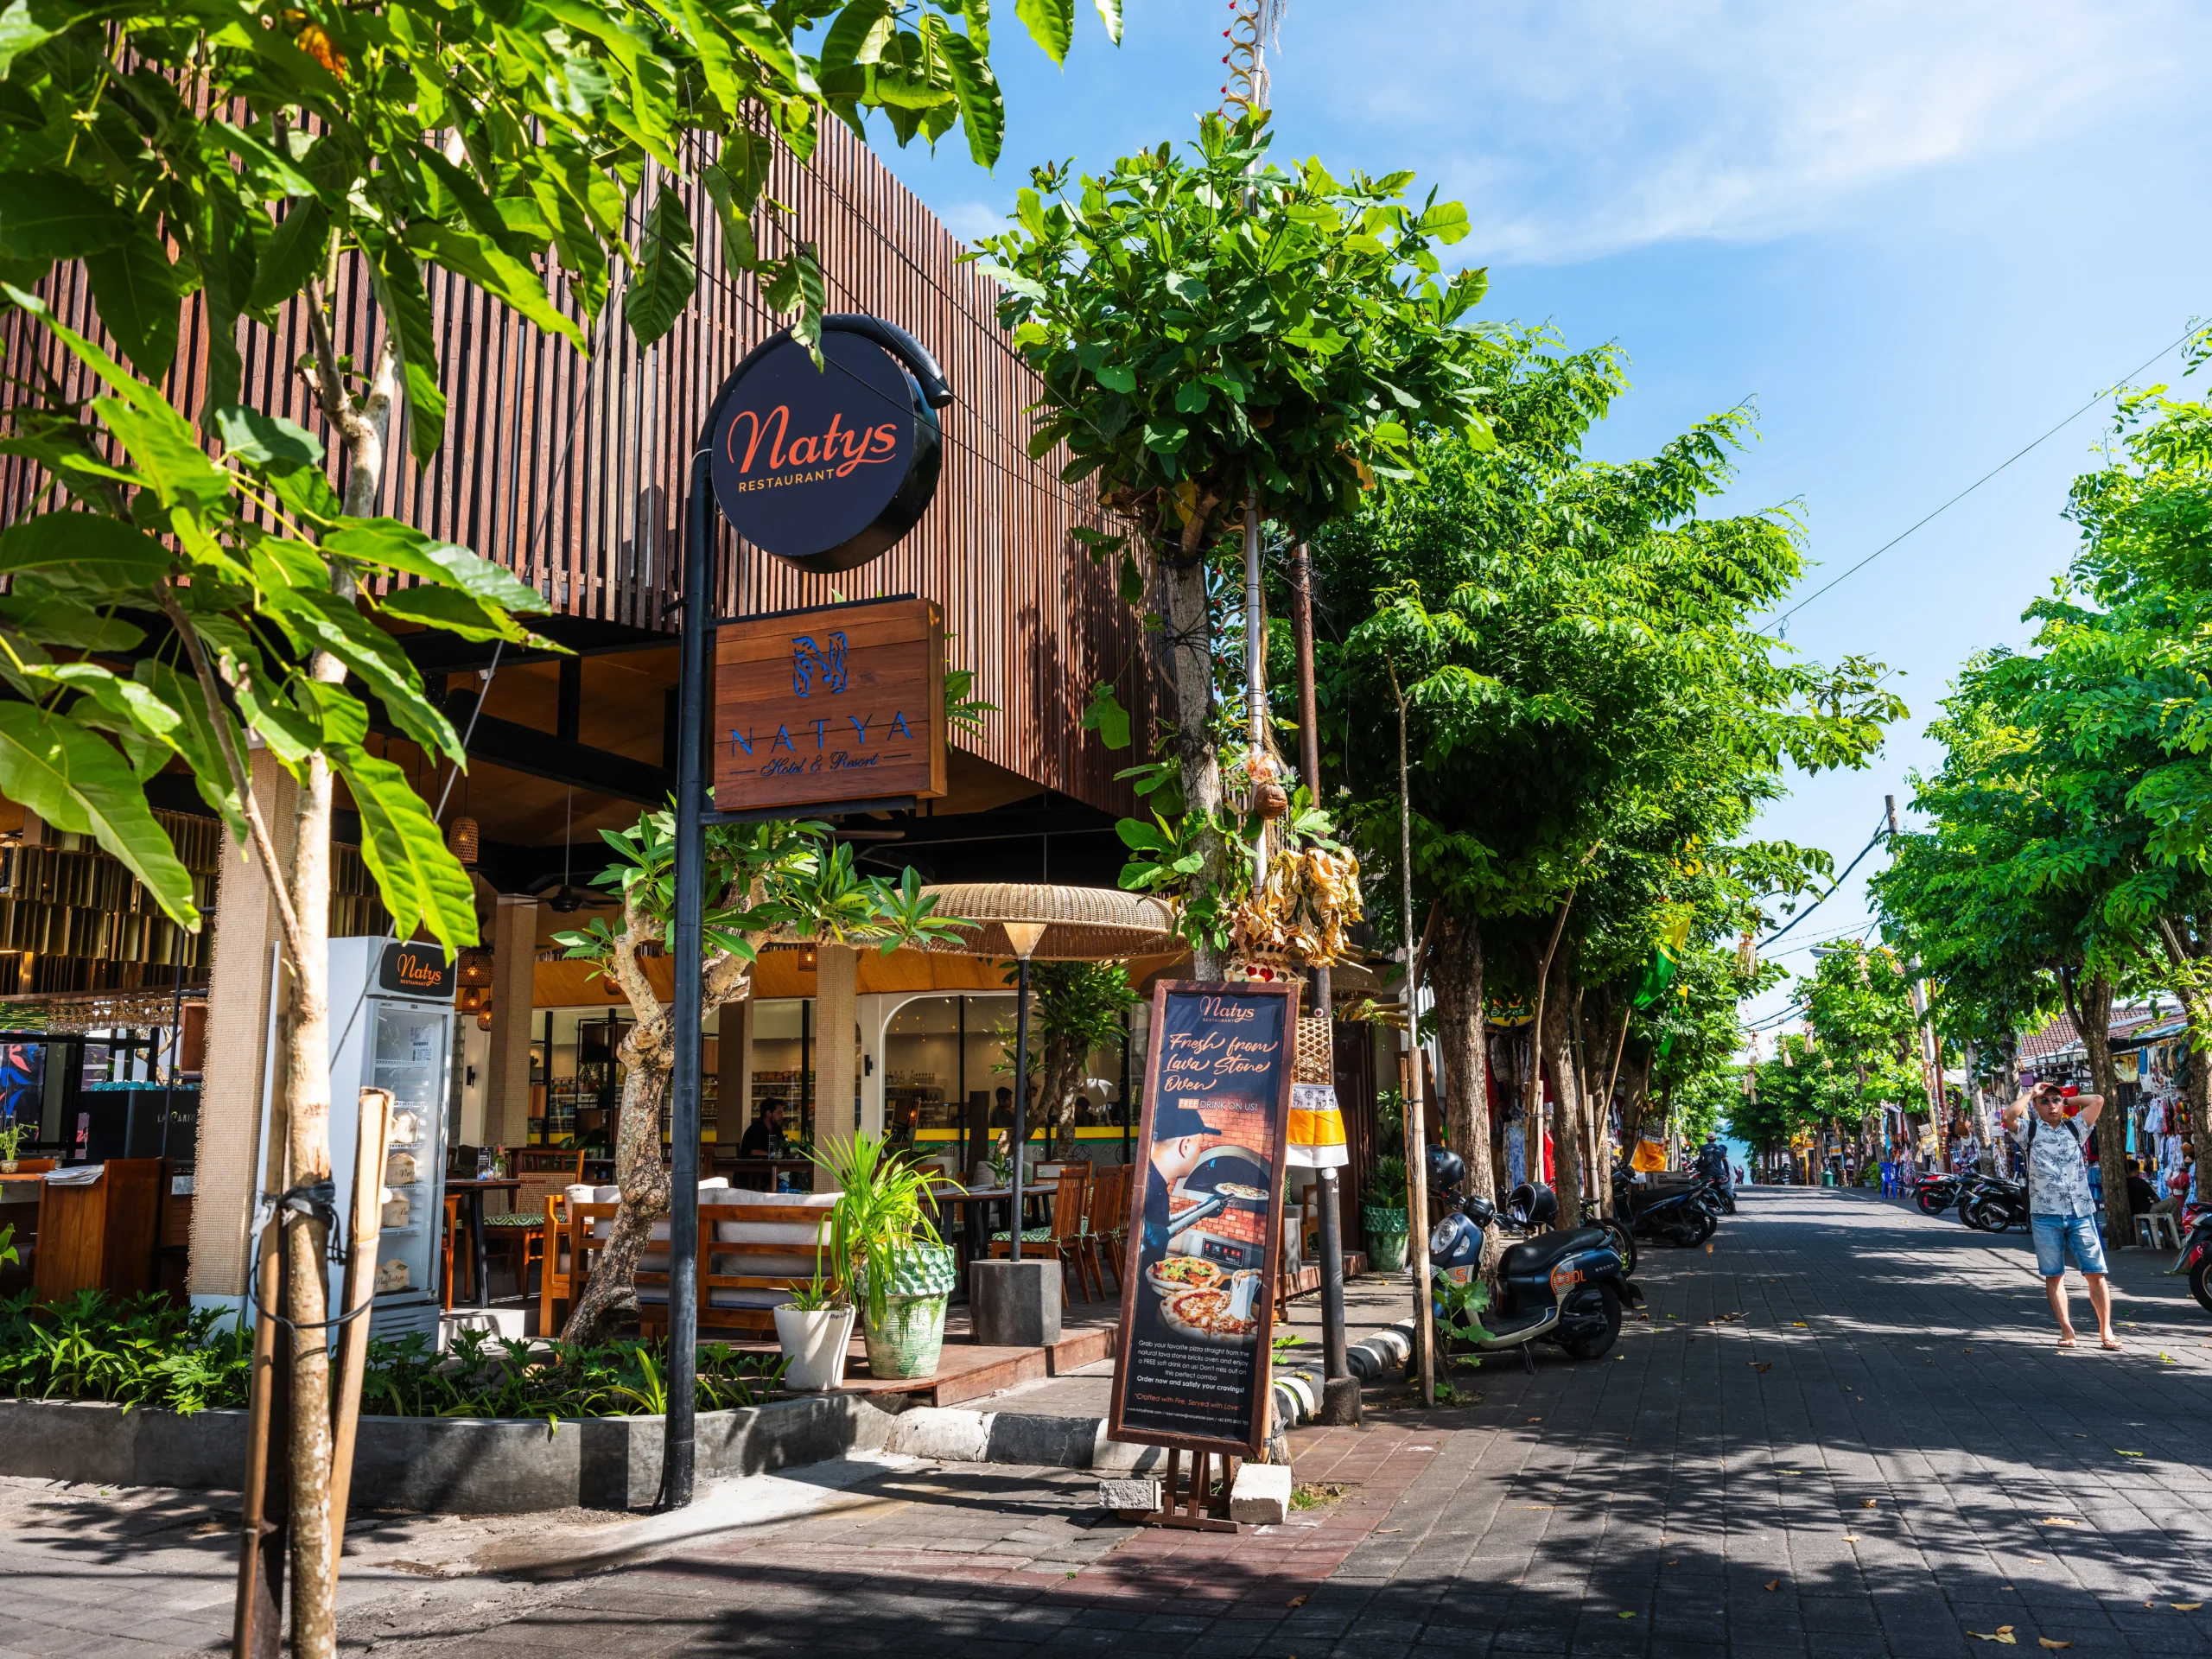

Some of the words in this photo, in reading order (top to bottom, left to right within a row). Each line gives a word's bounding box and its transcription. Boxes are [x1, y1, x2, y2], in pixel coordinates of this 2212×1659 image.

[728, 405, 897, 477] Natys
[739, 468, 834, 493] RESTAURANT
[729, 711, 913, 757] NATYA
[760, 758, 806, 777] Hotel
[810, 754, 823, 772] &
[830, 751, 879, 771] Resort
[397, 953, 442, 987] Natys
[1200, 995, 1255, 1023] Natys
[1170, 1031, 1225, 1054] Fresh
[1226, 1036, 1278, 1056] from
[1163, 1053, 1210, 1073] Lava
[1213, 1054, 1271, 1075] Stone
[1164, 1075, 1217, 1092] Oven
[1179, 1099, 1198, 1108] FREE
[1200, 1100, 1225, 1109] DRINK
[1228, 1102, 1242, 1110] ON
[1245, 1103, 1258, 1111] US!
[1555, 1269, 1587, 1287] COOL
[1217, 1385, 1245, 1394] cravings!
[1188, 1399, 1209, 1408] Served
